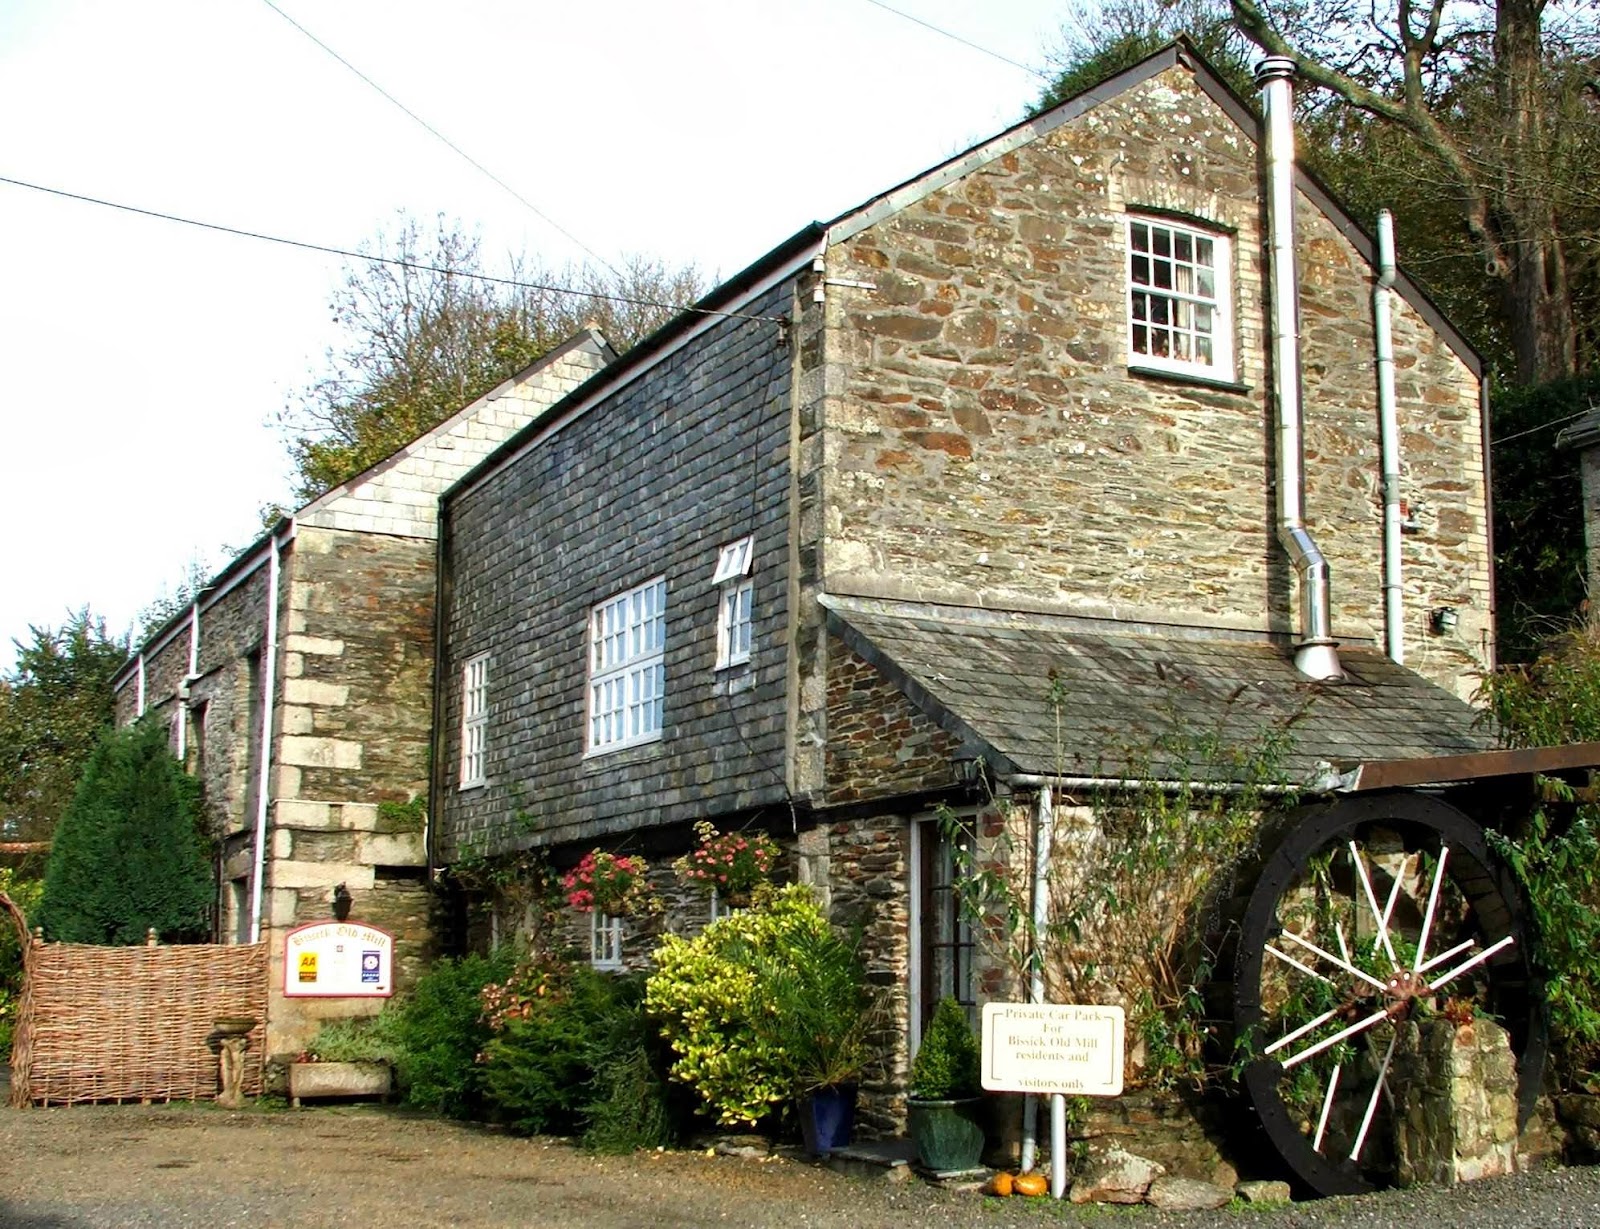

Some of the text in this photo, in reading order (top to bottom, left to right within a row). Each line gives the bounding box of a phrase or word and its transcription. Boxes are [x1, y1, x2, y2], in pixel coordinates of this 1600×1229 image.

[336, 925, 358, 938] Old
[360, 932, 387, 947] Mill
[300, 956, 316, 967] AA
[1005, 1008, 1102, 1021] Private Car Park
[1043, 1023, 1064, 1033] For
[1008, 1035, 1098, 1049] Bissick Old Mill
[1015, 1050, 1089, 1062] residents and
[1018, 1077, 1085, 1091] visitors only
